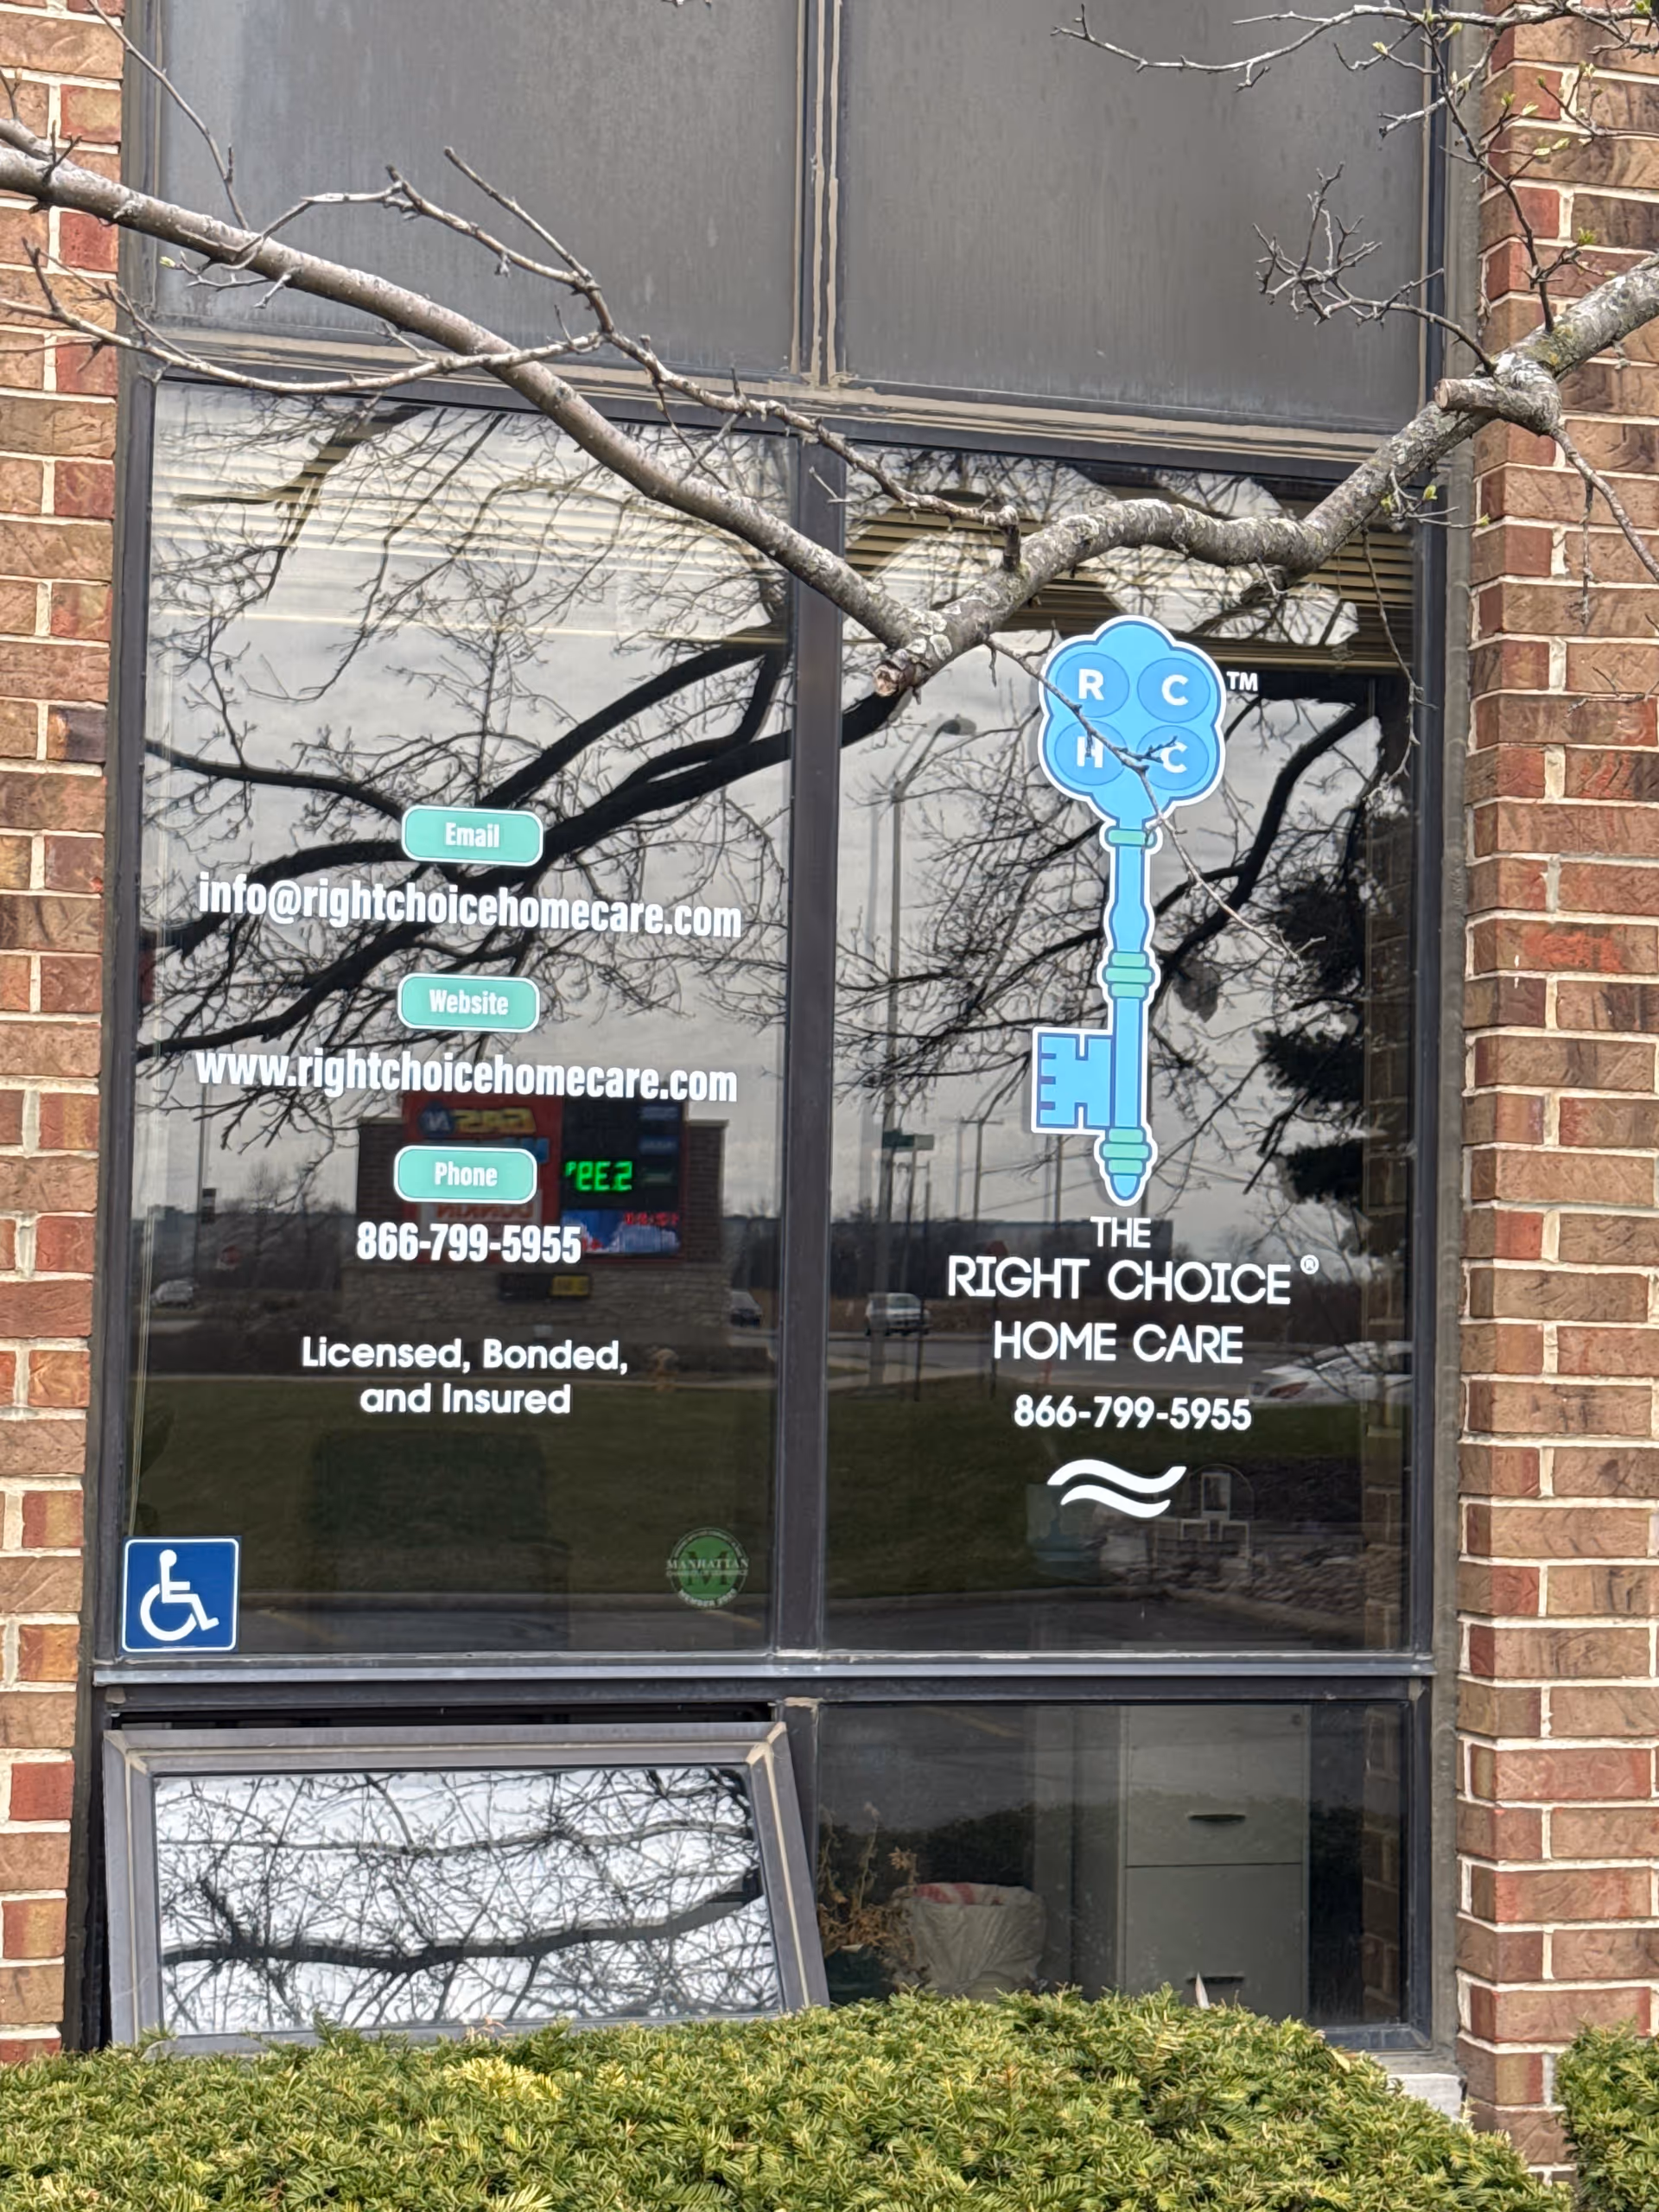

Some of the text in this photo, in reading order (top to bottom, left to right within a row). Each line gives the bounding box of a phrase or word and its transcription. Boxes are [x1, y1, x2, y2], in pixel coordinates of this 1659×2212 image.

[1078, 668, 1189, 706] R C
[1226, 671, 1258, 691] TM
[1077, 735, 1188, 773] H C
[445, 822, 500, 849] Email
[199, 871, 741, 938] info@rightchoicehomecare.com
[429, 989, 509, 1016] Website
[195, 1046, 737, 1102] www.rightchoicehomecare.com
[435, 1161, 498, 1186] Phone
[356, 1221, 582, 1263] 866-799-5955
[1090, 1216, 1152, 1249] THE
[948, 1255, 1090, 1299] RIGHT
[1108, 1259, 1292, 1305] CHOICE
[302, 1337, 628, 1376] Licensed, Bonded,
[994, 1320, 1244, 1364] HOME CARE
[359, 1382, 571, 1414] and Insured
[1014, 1394, 1252, 1431] 866-799-5955
[665, 1558, 749, 1569] MANHATTAN
